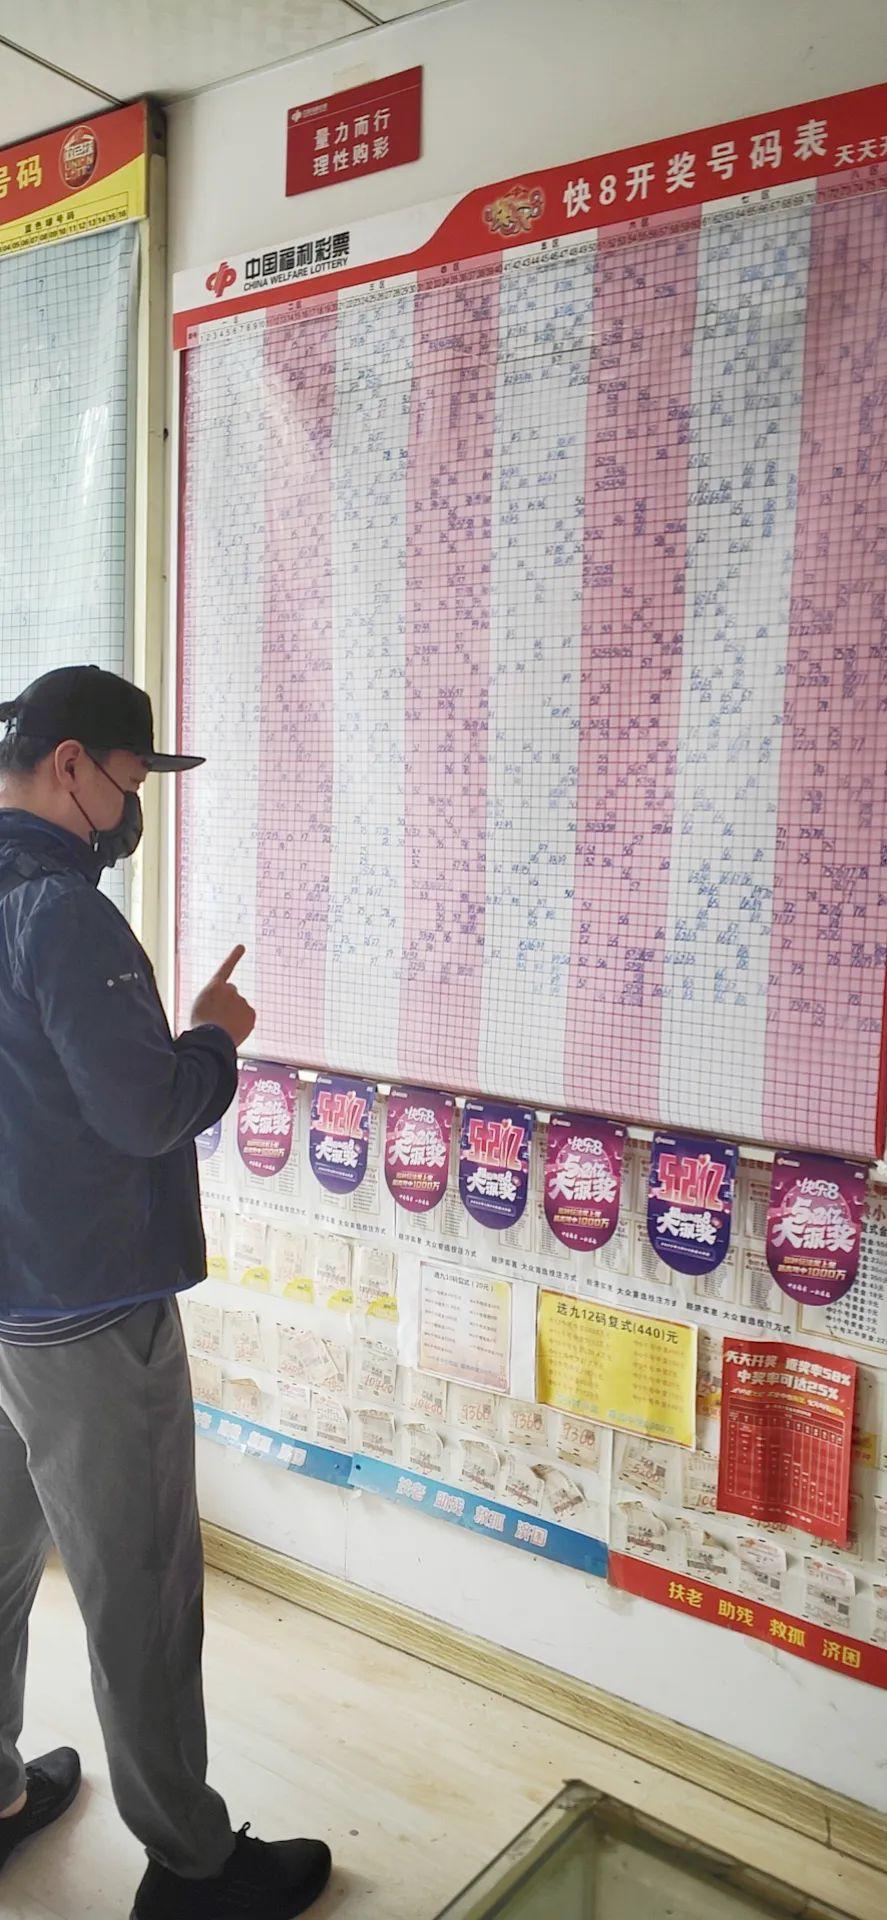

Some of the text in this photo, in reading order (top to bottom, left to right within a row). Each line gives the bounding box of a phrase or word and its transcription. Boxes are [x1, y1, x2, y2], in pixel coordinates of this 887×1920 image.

[314, 108, 391, 151] 量力而行
[313, 136, 389, 176] 理性购彩
[564, 117, 829, 219] 快8开奖号码表
[244, 257, 349, 292] CHINA WELFARE LOTTERY
[245, 231, 350, 280] 中国福利彩票
[725, 1350, 778, 1367] 天天开奖
[668, 1581, 861, 1669] 扶老 助残 救孤 济困
